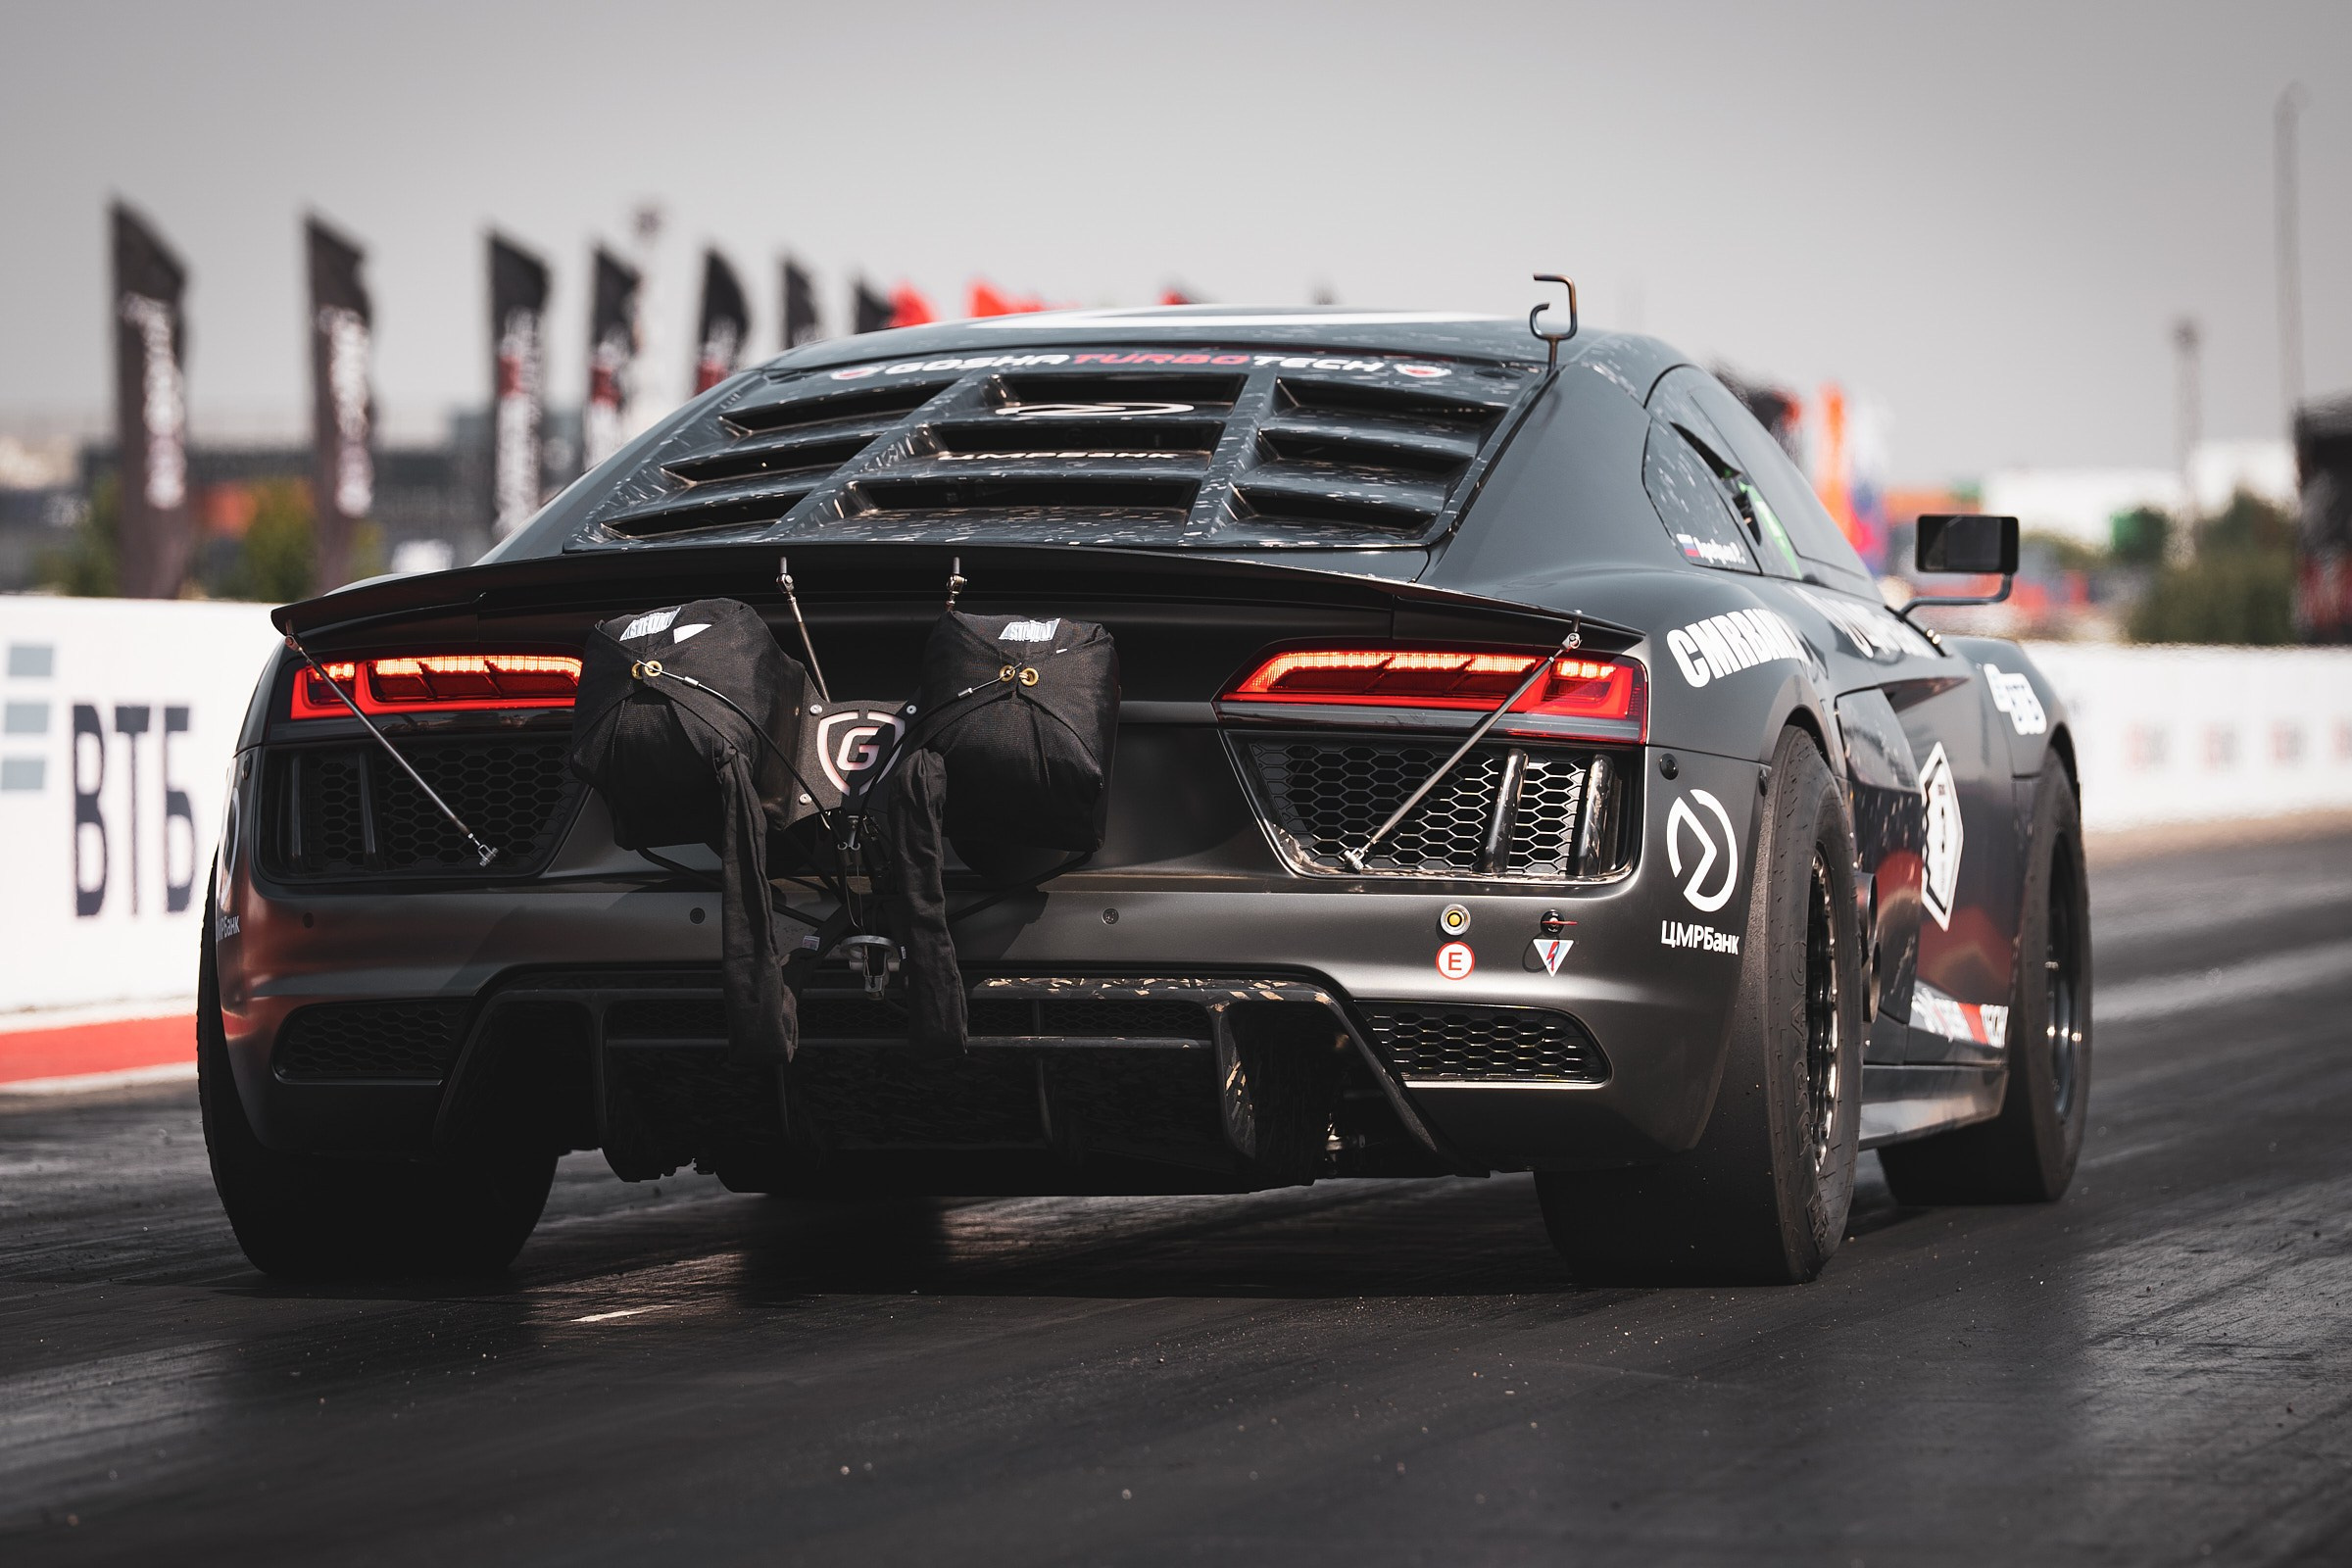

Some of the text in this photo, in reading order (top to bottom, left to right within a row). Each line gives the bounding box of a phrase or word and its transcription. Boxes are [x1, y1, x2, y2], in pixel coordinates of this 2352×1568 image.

[836, 725, 880, 771] G
[73, 704, 196, 917] ВТБ
[1661, 920, 1740, 956] ЦМРБанк
[1447, 952, 1463, 971] E
